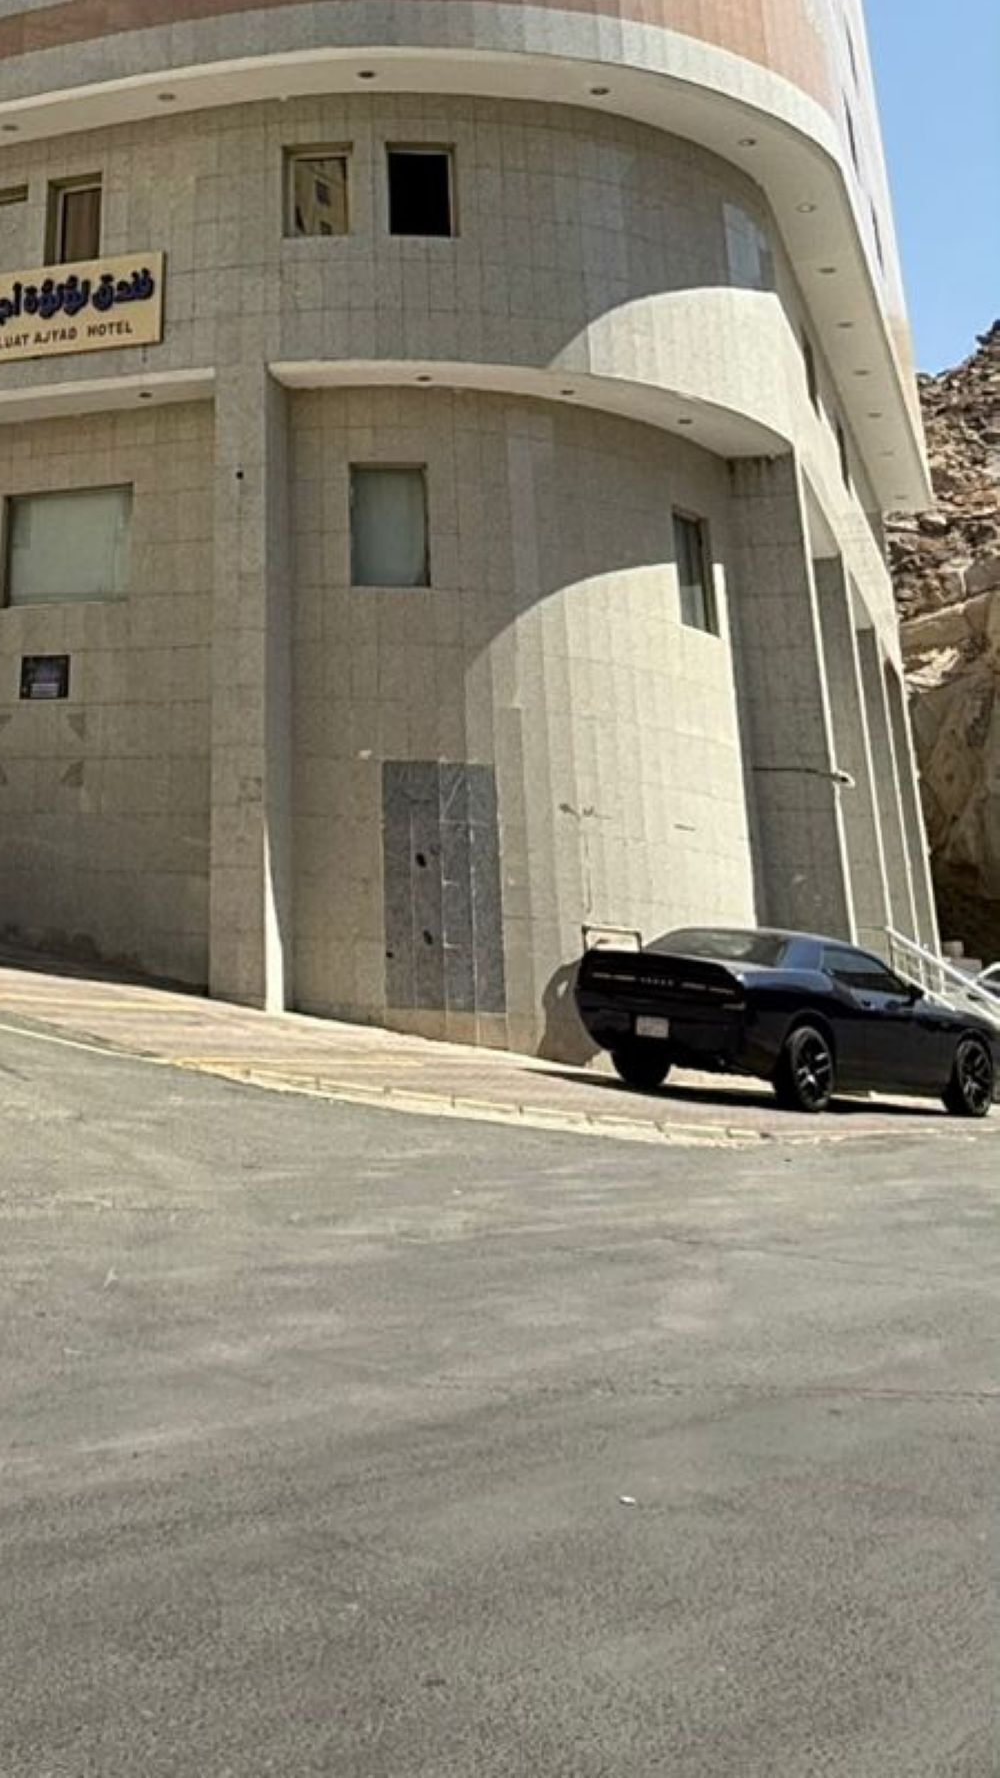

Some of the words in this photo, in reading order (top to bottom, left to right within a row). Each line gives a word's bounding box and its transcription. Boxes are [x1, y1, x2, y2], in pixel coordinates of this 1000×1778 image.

[92, 267, 155, 312] فندق
[34, 327, 78, 344] AJYAD
[87, 320, 133, 338] HOTEL
